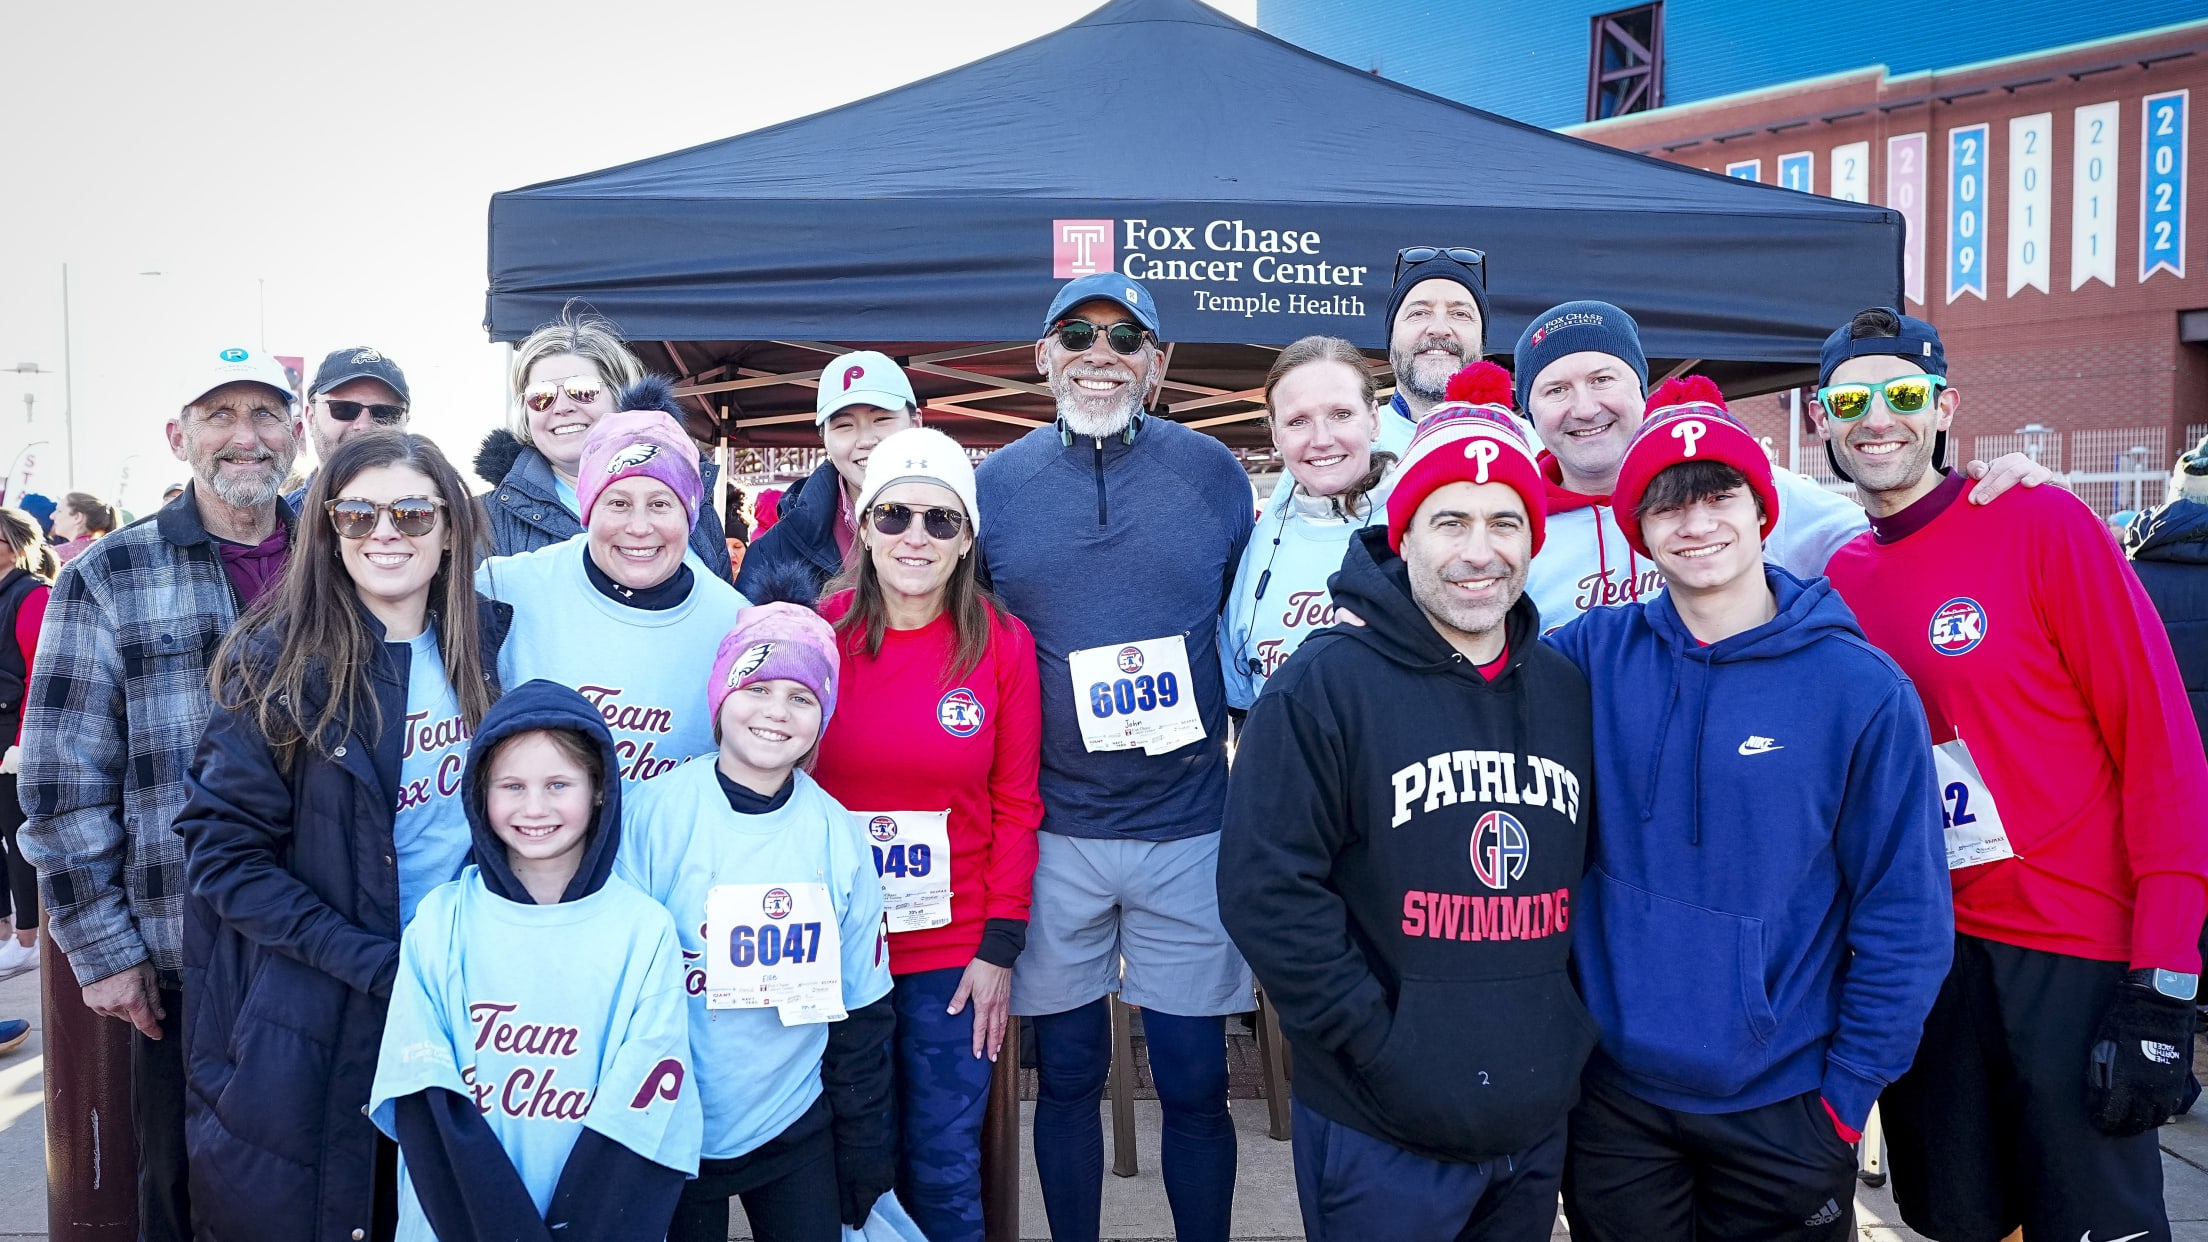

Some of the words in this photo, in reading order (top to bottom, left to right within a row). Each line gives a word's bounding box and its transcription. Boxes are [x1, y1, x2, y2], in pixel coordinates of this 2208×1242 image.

[2023, 130, 2037, 265] 2010
[2089, 119, 2103, 256] 2011
[2154, 105, 2174, 250] 2022
[1959, 138, 1977, 273] 2009
[1123, 219, 1196, 250] Fox
[1204, 220, 1321, 255] Chase
[1123, 253, 1243, 282] Cancer
[1252, 256, 1367, 287] Center
[1194, 290, 1281, 317] Temple
[1287, 294, 1366, 316] Health
[1671, 420, 1707, 457] P
[1463, 440, 1500, 484] P
[1282, 590, 1336, 628] Tea
[1089, 671, 1179, 718] 6039
[615, 741, 694, 780] Cha
[1746, 735, 1775, 749] NIKE
[1470, 810, 1530, 889] GA
[1402, 887, 1570, 941] SWIMMING
[729, 922, 822, 968] 6047
[470, 1003, 579, 1056] Team
[2157, 1042, 2175, 1051] FACE
[2156, 1049, 2180, 1060] NORTH
[501, 1067, 590, 1120] Cha
